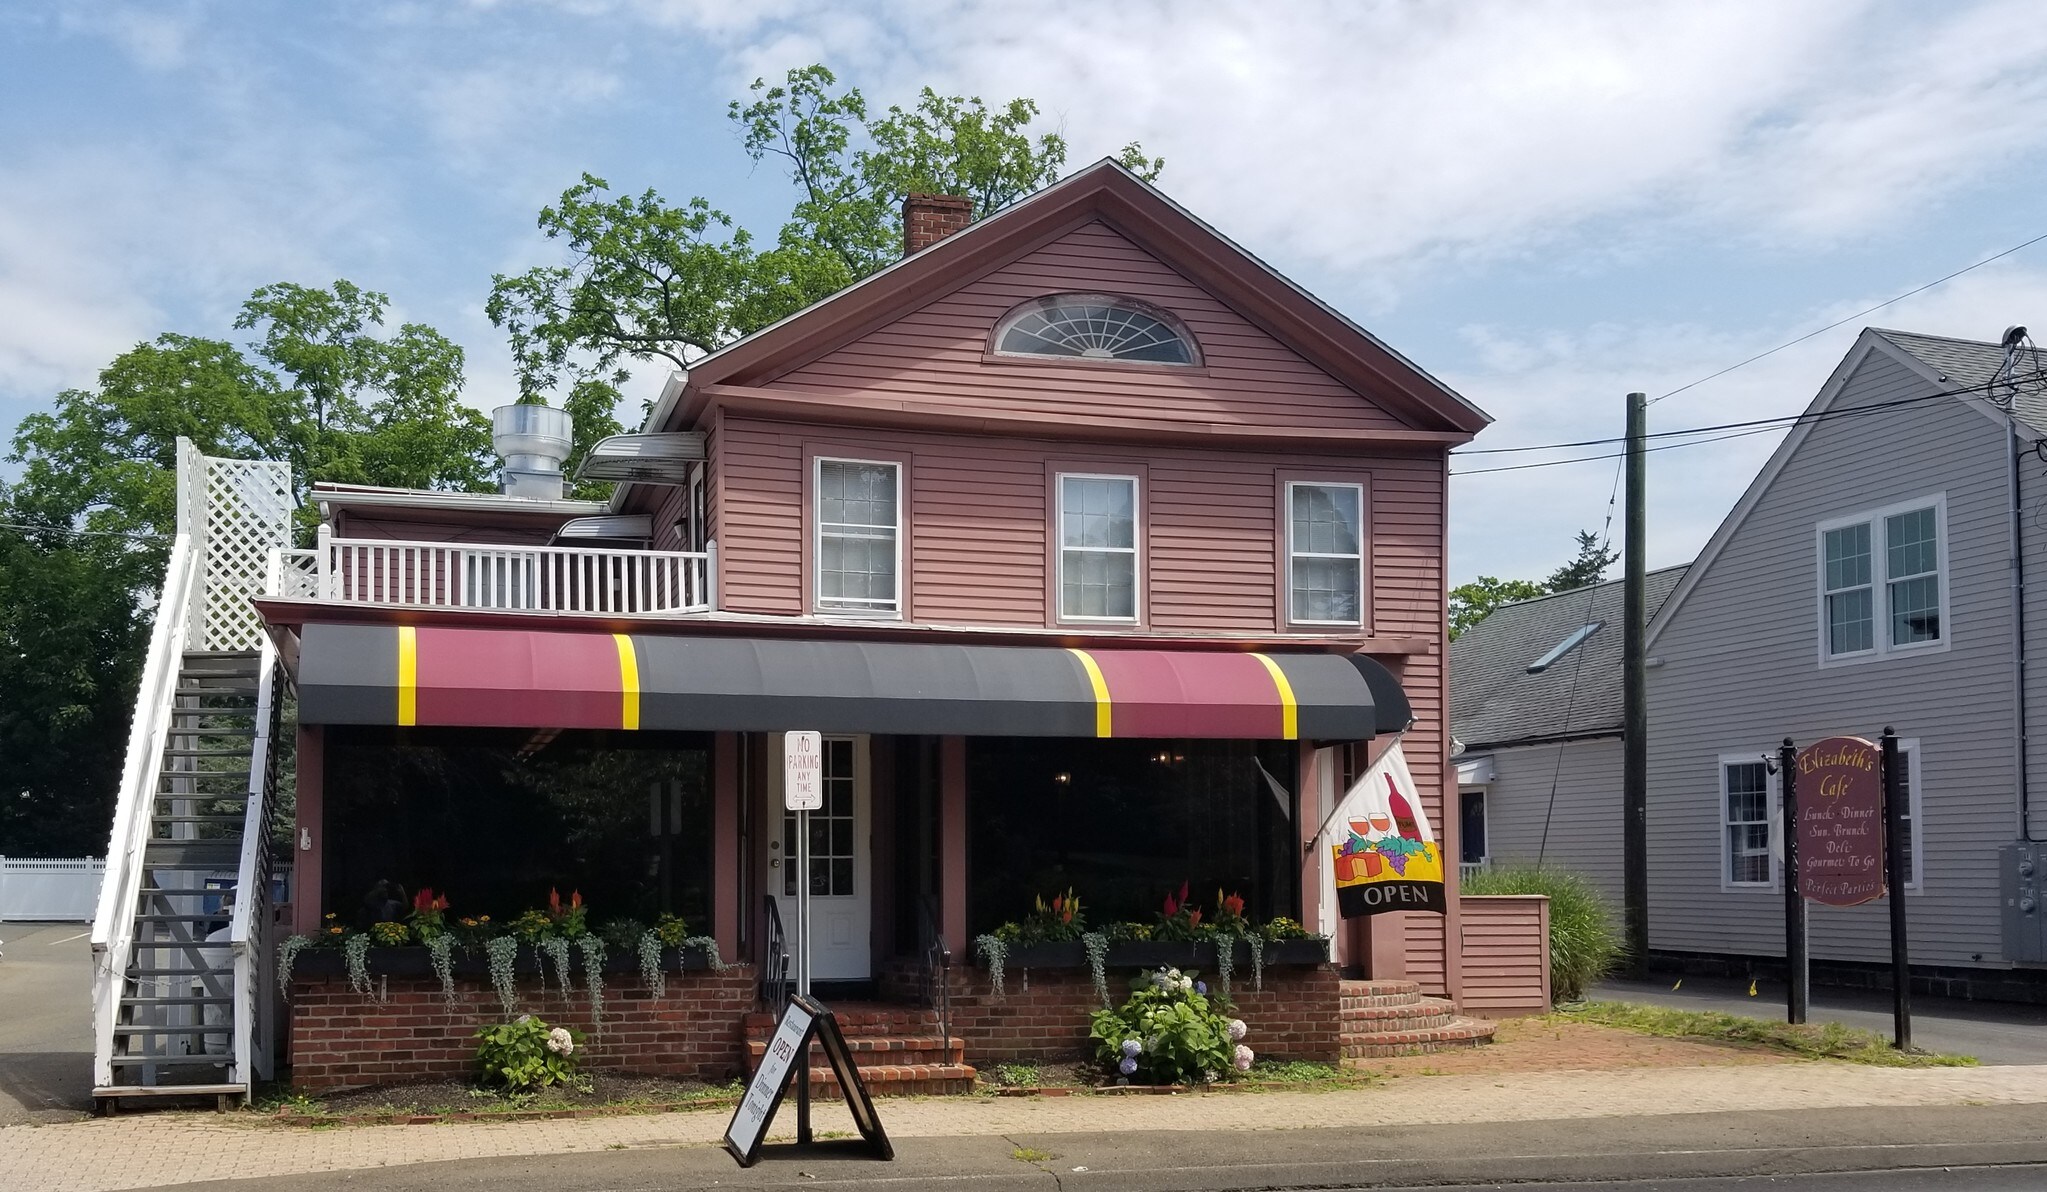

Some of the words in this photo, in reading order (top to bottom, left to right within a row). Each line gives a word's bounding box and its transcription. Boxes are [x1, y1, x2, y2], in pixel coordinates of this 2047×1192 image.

[798, 739, 810, 752] NO
[789, 755, 818, 769] PARKING
[1799, 745, 1873, 774] Elizabeth's
[798, 772, 810, 781] ANY
[797, 783, 811, 792] TIME
[1820, 775, 1853, 803] Café
[1804, 806, 1834, 820] Lunch
[1840, 806, 1874, 819] Dinner
[1834, 821, 1869, 836] Brunch
[1826, 840, 1852, 853] Deli
[1848, 855, 1860, 867] To
[1863, 855, 1874, 871] Go
[1805, 879, 1837, 895] Perfect
[1840, 881, 1874, 895] Parties
[1364, 886, 1428, 905] OPEN
[772, 1037, 794, 1063] OPEN
[755, 1074, 774, 1100] Dinner
[744, 1093, 766, 1123] Tonight
